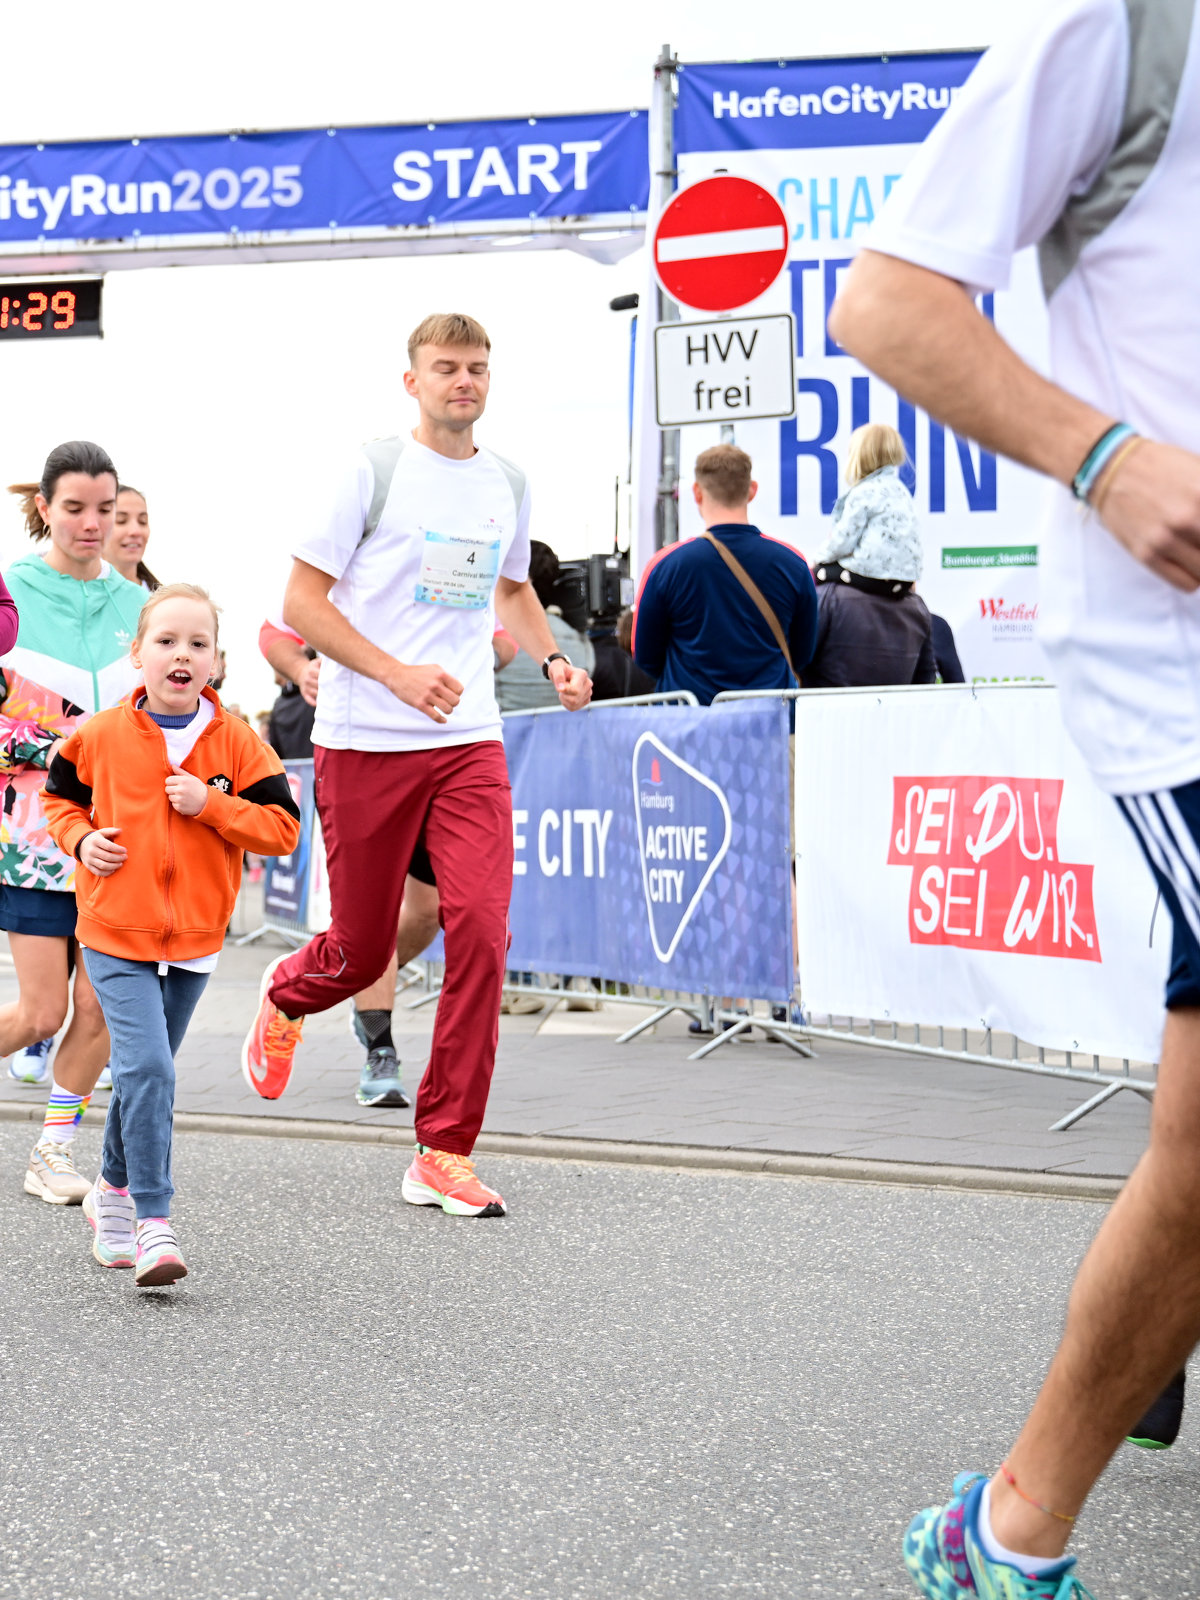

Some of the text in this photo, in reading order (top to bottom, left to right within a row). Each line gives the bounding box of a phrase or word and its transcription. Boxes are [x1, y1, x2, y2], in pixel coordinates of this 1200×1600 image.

[711, 81, 963, 121] HafenCityRu
[391, 139, 602, 202] START
[685, 328, 759, 366] HVV
[693, 376, 752, 412] frei
[452, 569, 478, 579] Carnival
[466, 551, 476, 566] 4
[978, 597, 1039, 621] Westfiel
[640, 791, 675, 813] Hamburg
[895, 782, 1054, 864] SEI DU.
[537, 808, 614, 878] CITY
[646, 825, 708, 861] ACTIVE
[649, 867, 685, 904] CITY
[913, 865, 1094, 948] SEI WIR.
